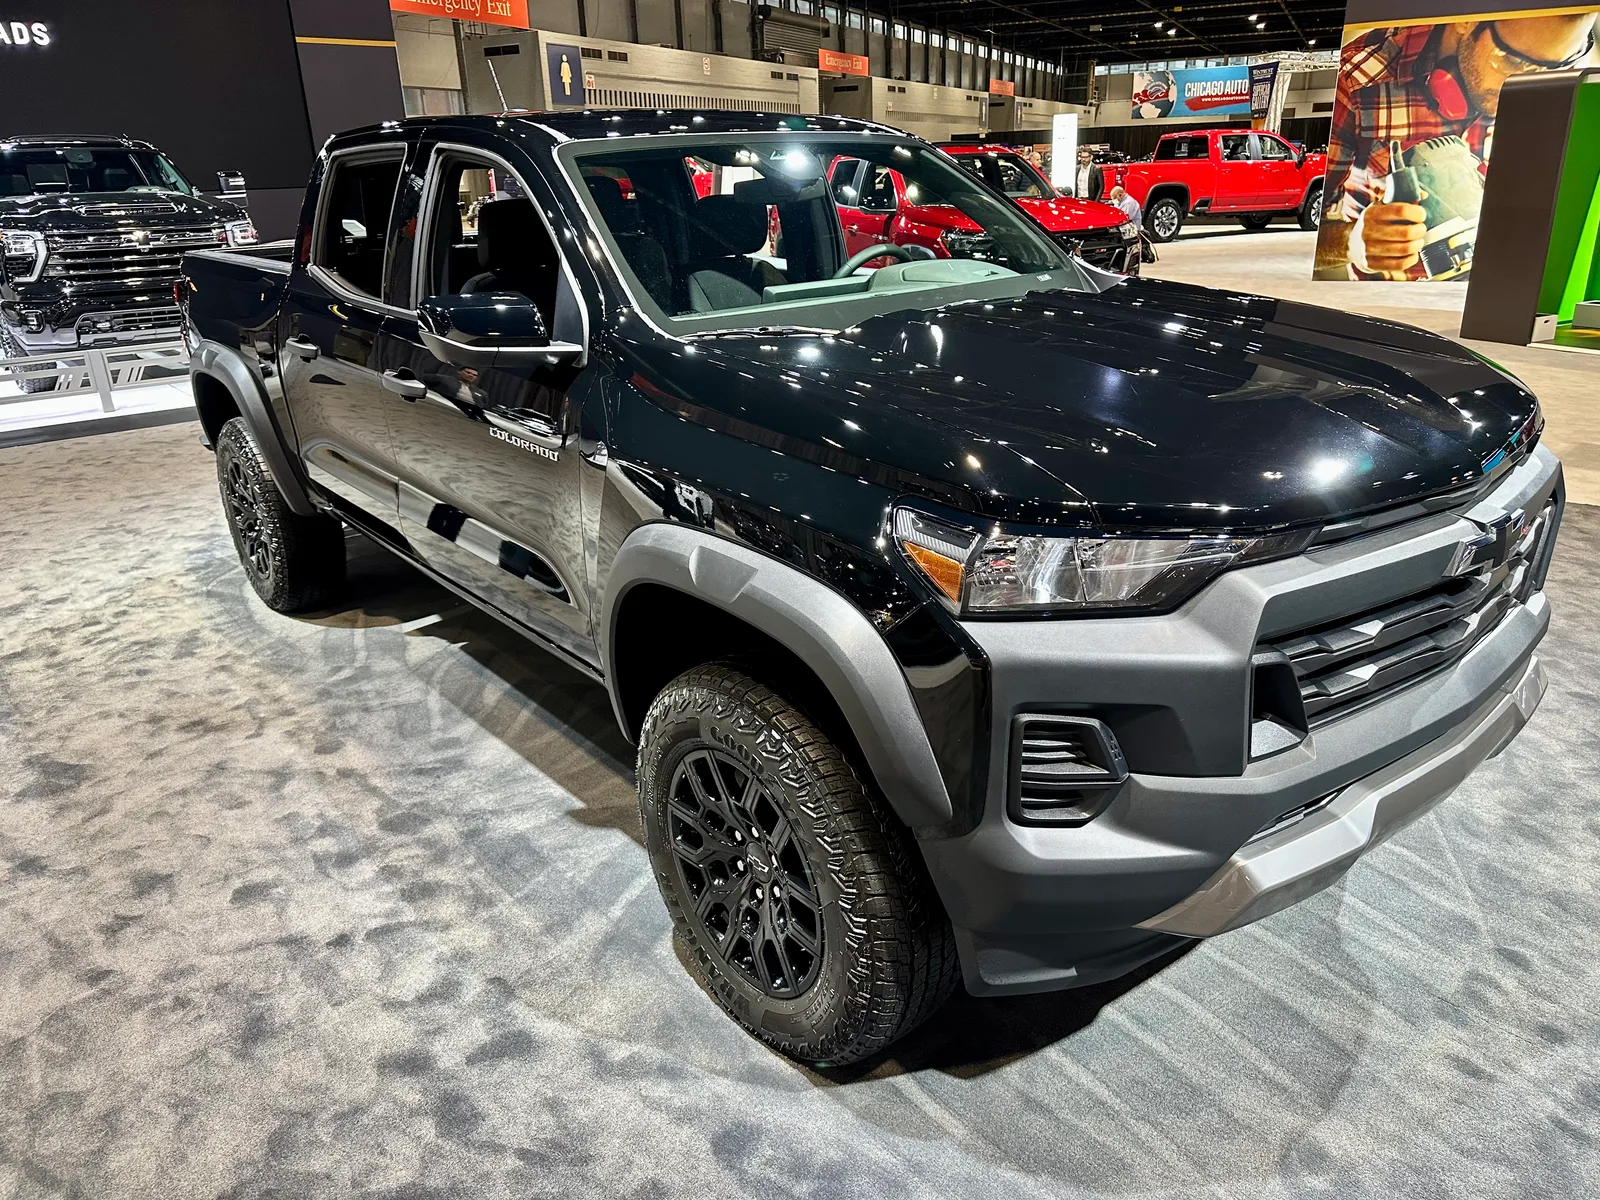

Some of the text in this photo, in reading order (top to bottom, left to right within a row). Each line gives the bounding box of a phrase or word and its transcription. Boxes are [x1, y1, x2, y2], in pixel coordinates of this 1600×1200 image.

[487, 0, 512, 17] Exit
[1184, 80, 1224, 97] CHICAGO
[1224, 79, 1249, 95] AUTO
[488, 427, 560, 462] COLORADO
